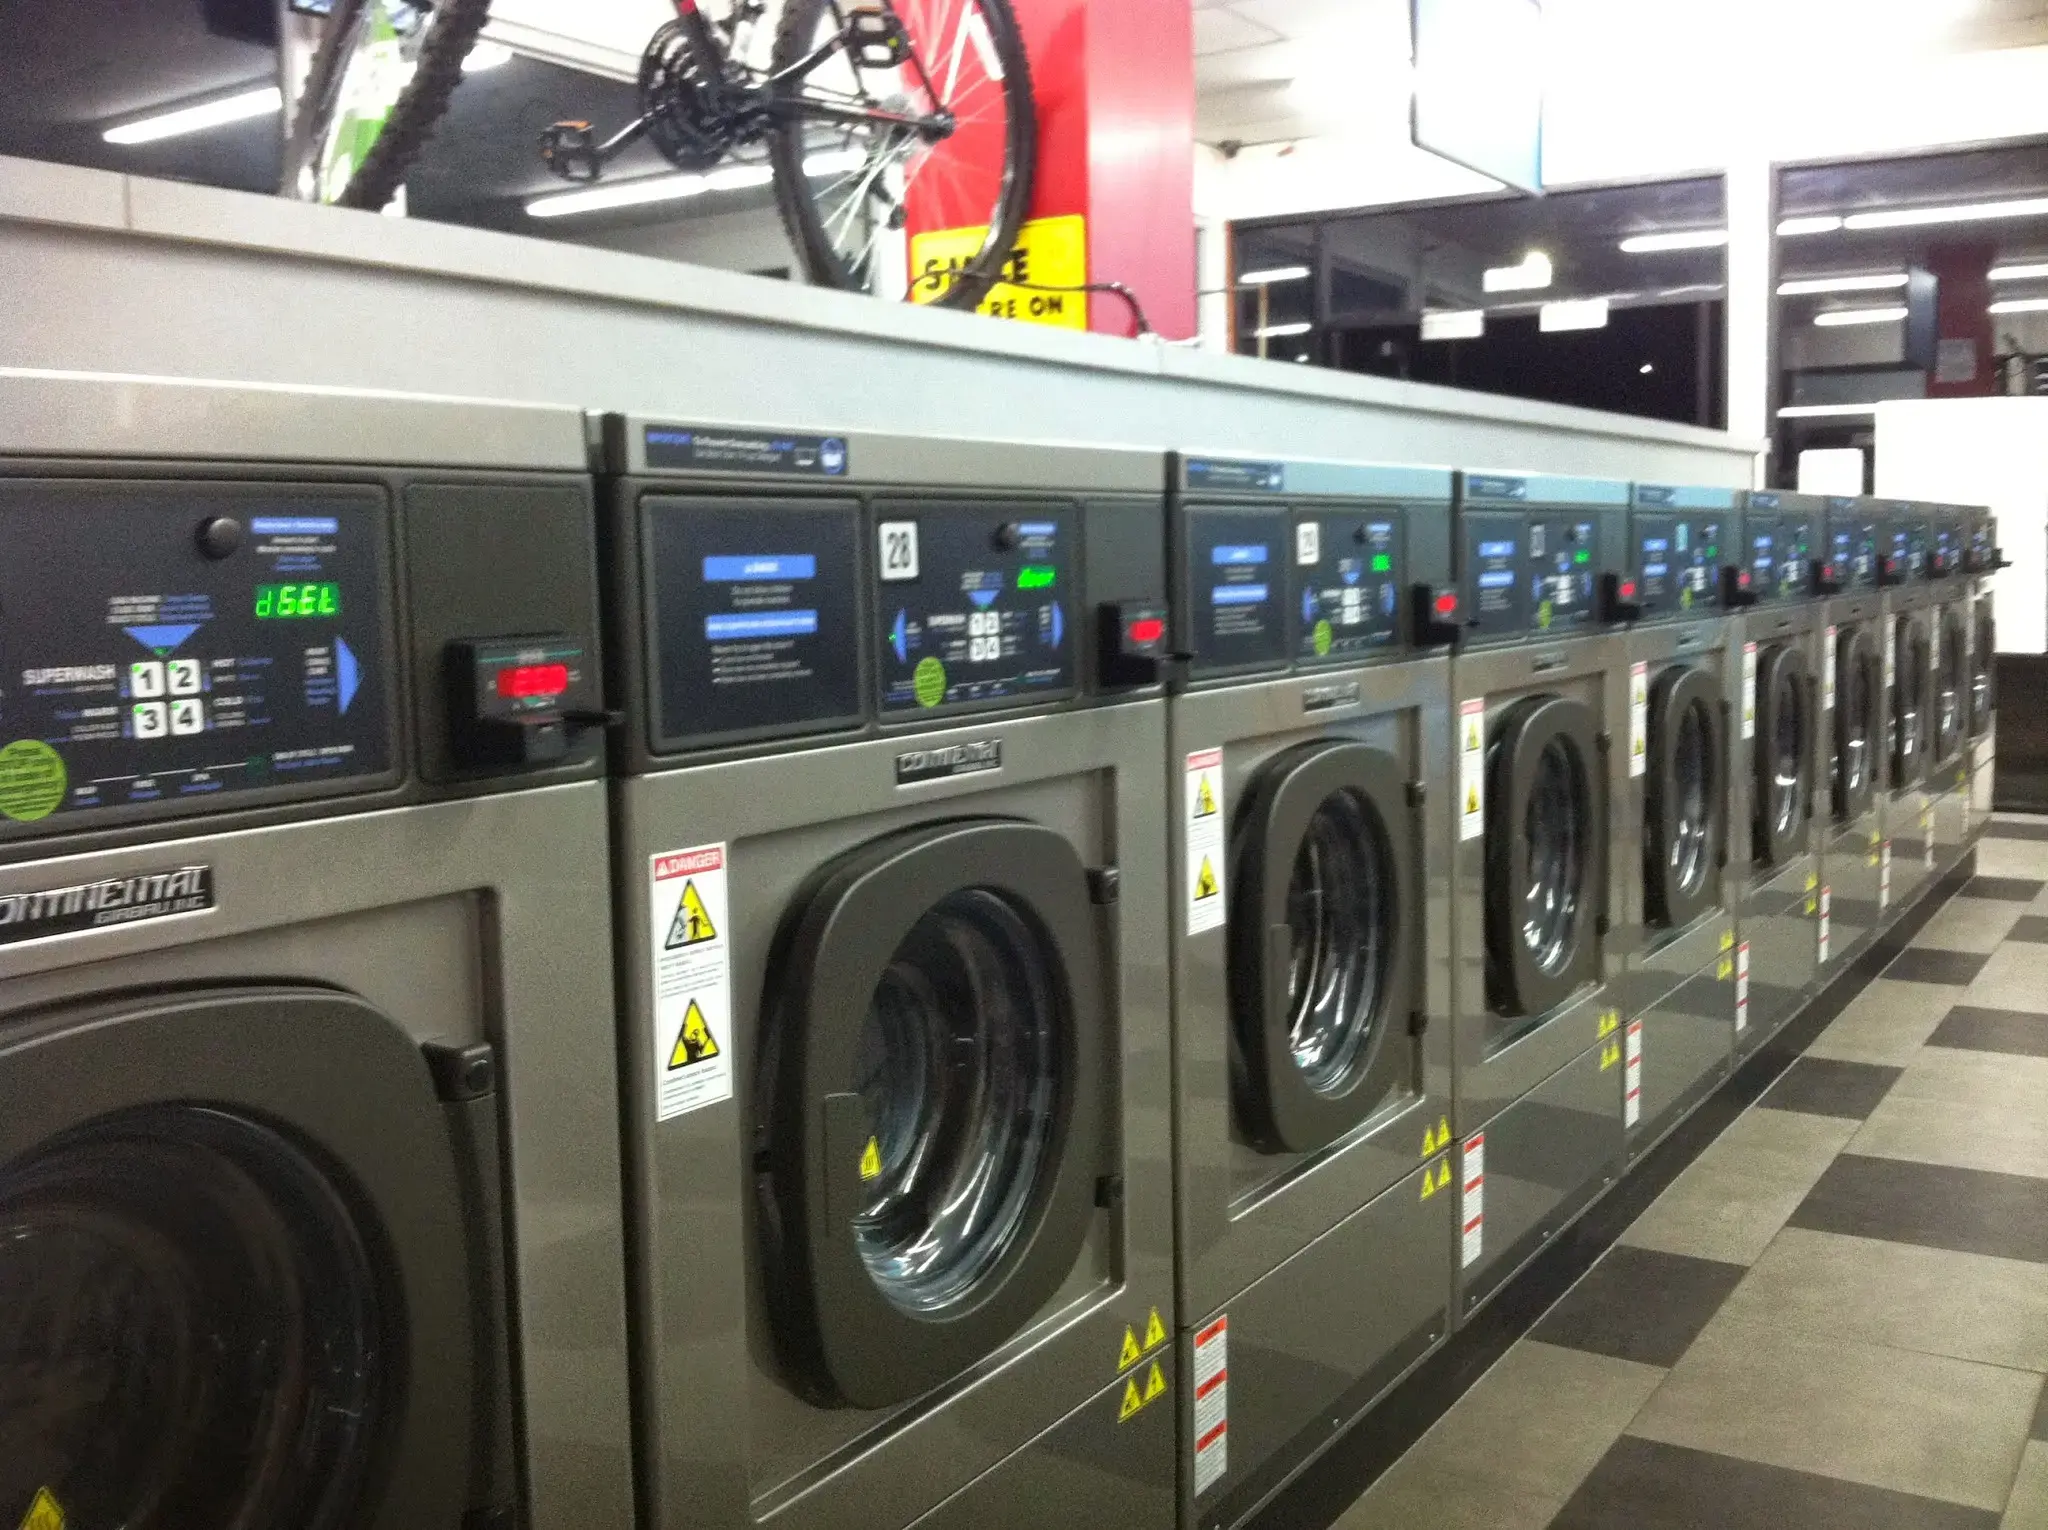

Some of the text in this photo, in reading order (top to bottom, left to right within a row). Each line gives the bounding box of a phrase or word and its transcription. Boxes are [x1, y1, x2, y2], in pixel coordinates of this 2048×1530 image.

[989, 300, 1017, 319] RE
[141, 666, 153, 690] 1
[176, 666, 192, 688] 2
[143, 710, 159, 731] 3
[179, 705, 194, 727] 4
[0, 870, 206, 924] ONTINENTAL
